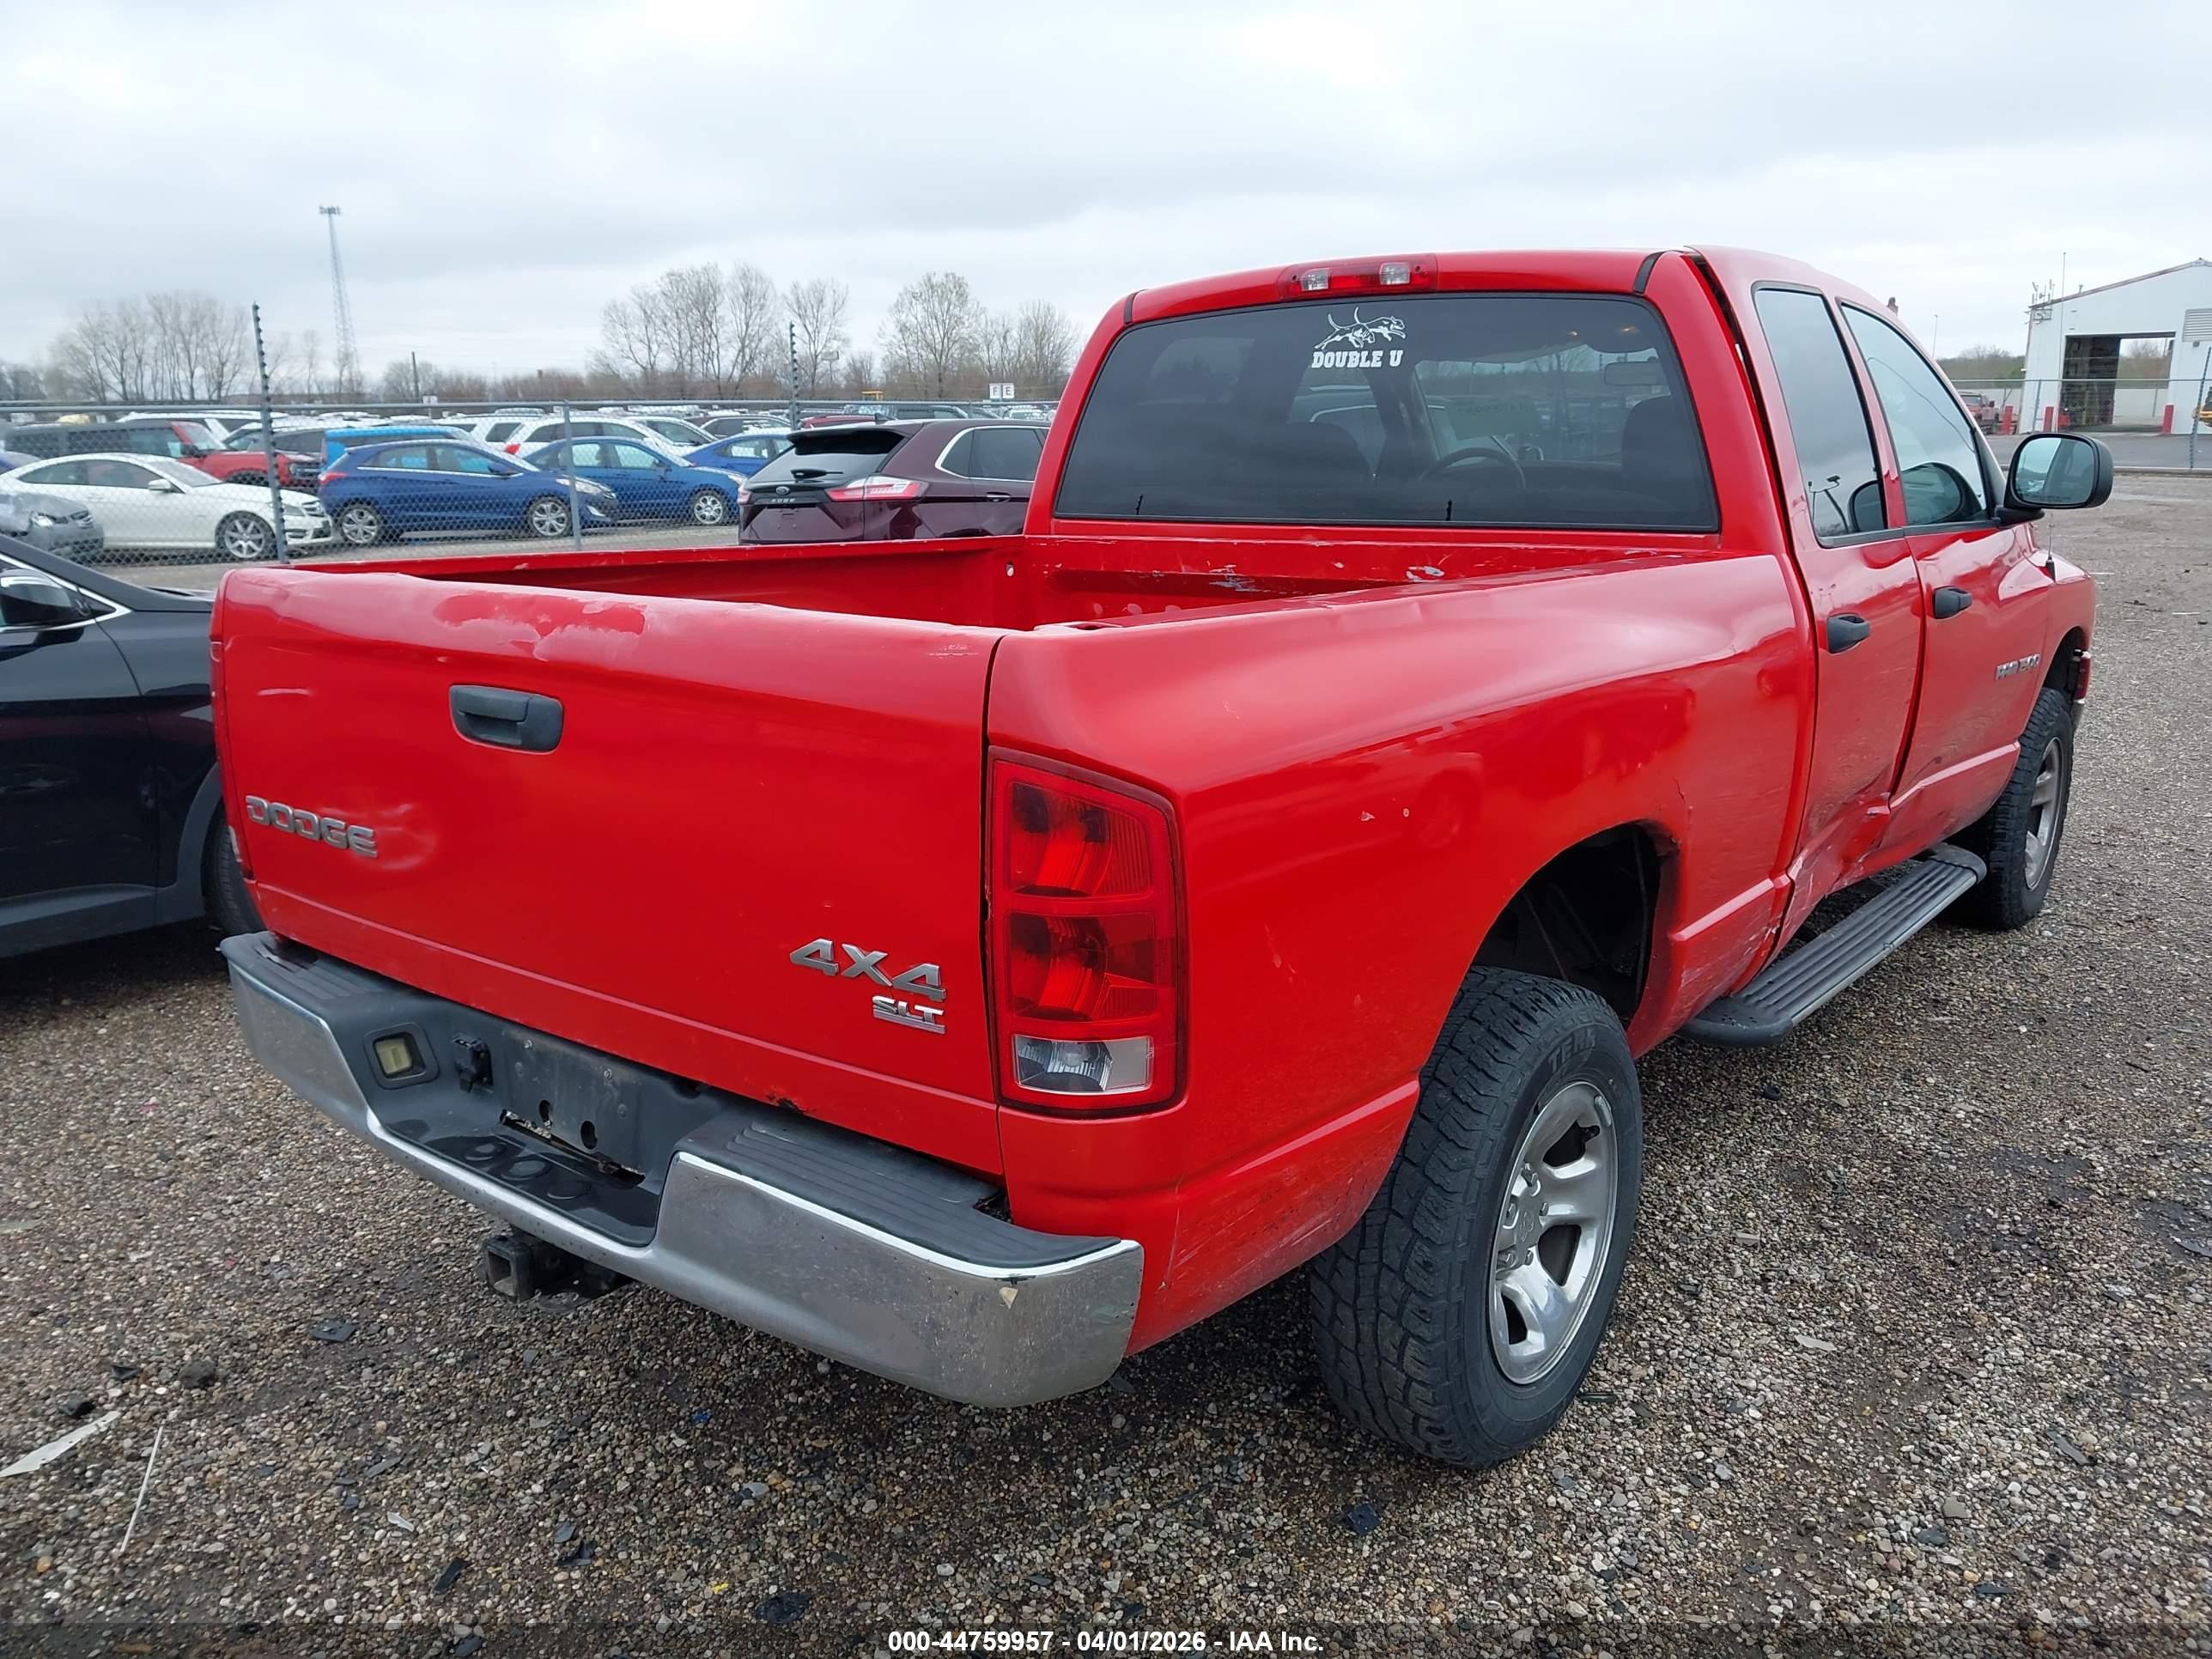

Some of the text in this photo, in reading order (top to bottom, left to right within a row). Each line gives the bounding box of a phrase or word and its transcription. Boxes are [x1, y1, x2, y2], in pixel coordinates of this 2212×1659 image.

[1311, 349, 1403, 368] DOUBLE U
[246, 795, 378, 859] DODGE
[872, 995, 945, 1026] SLT
